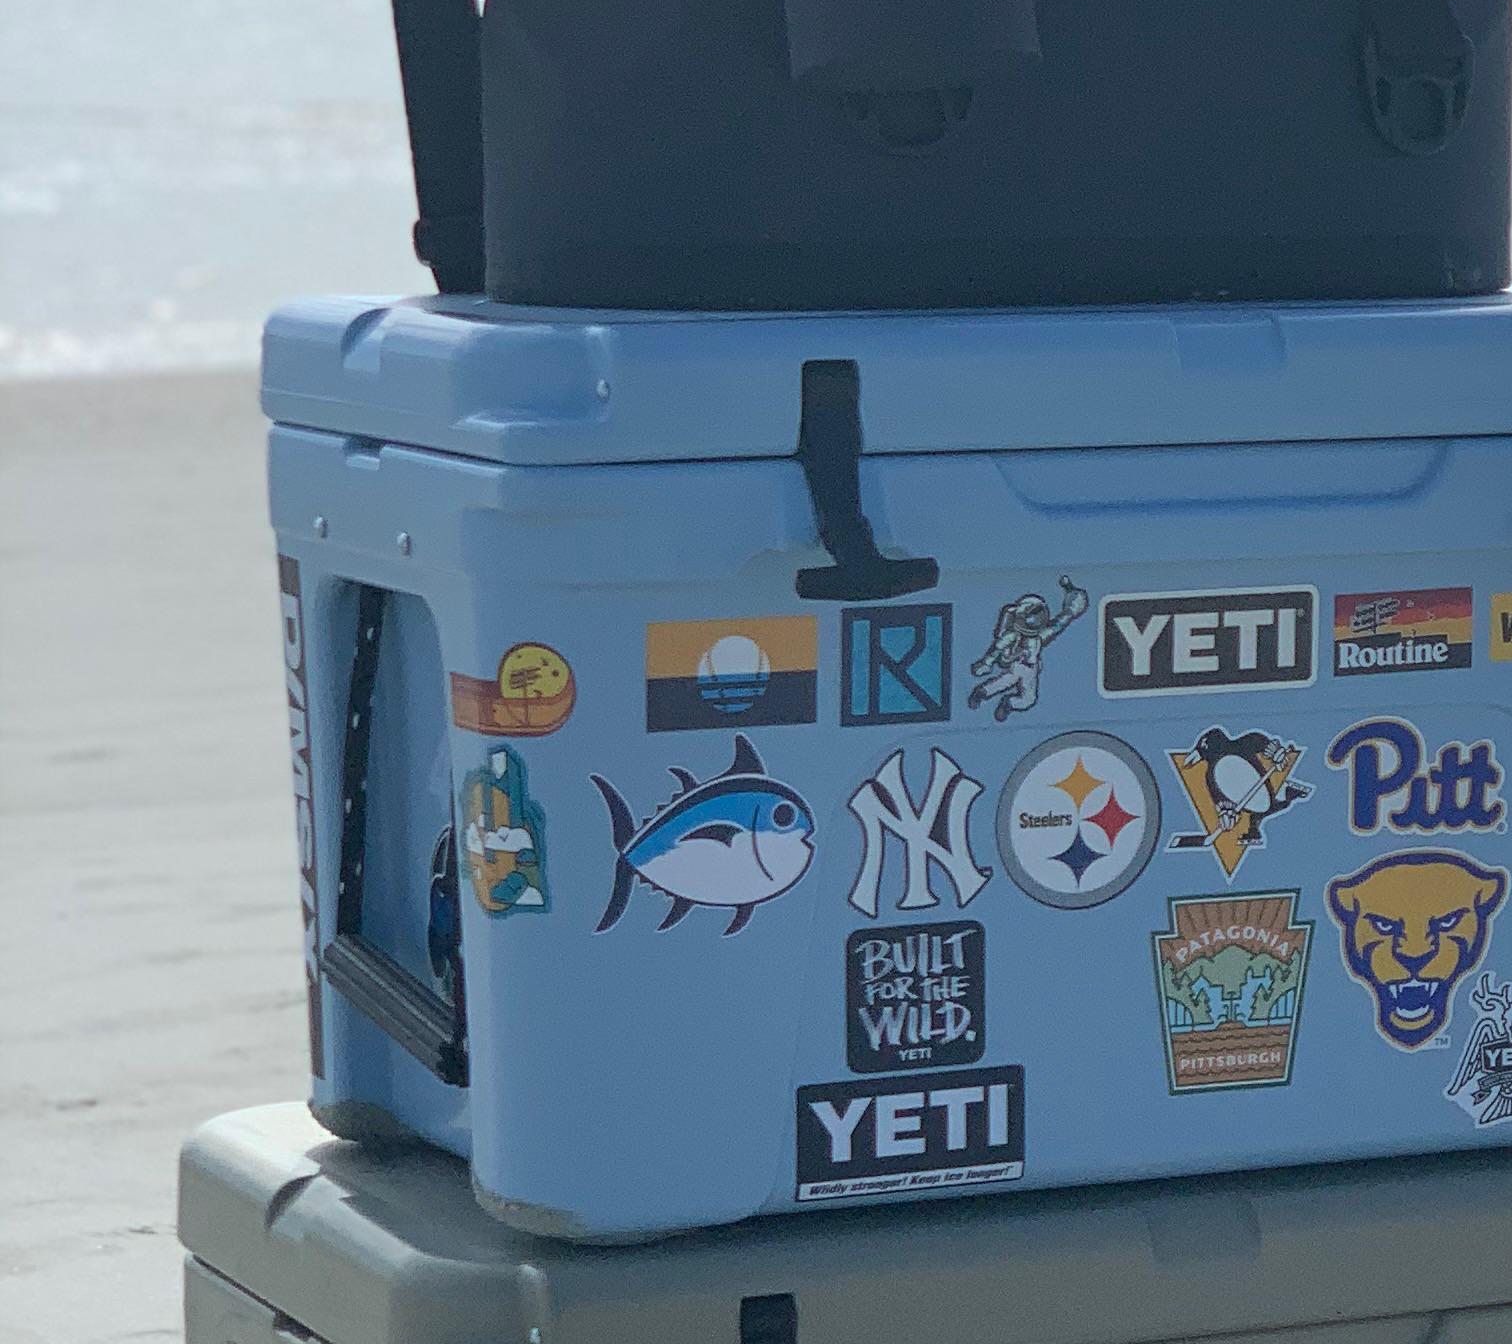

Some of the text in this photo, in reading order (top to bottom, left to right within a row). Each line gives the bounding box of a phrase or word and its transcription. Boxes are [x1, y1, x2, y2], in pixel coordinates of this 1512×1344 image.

[1113, 607, 1300, 676] YETI
[1339, 640, 1448, 668] Routine
[1328, 719, 1503, 833] Pitt
[1019, 811, 1072, 829] Steelers
[855, 929, 977, 983] BUILT
[1175, 925, 1290, 963] PATAGONIA
[867, 975, 970, 1003] FOR THE
[858, 1001, 977, 1050] WILD.
[899, 1048, 931, 1060] YETI
[1180, 1052, 1281, 1070] PITTSBURGH
[809, 1083, 1008, 1163] YETI
[910, 1174, 941, 1186] Keep
